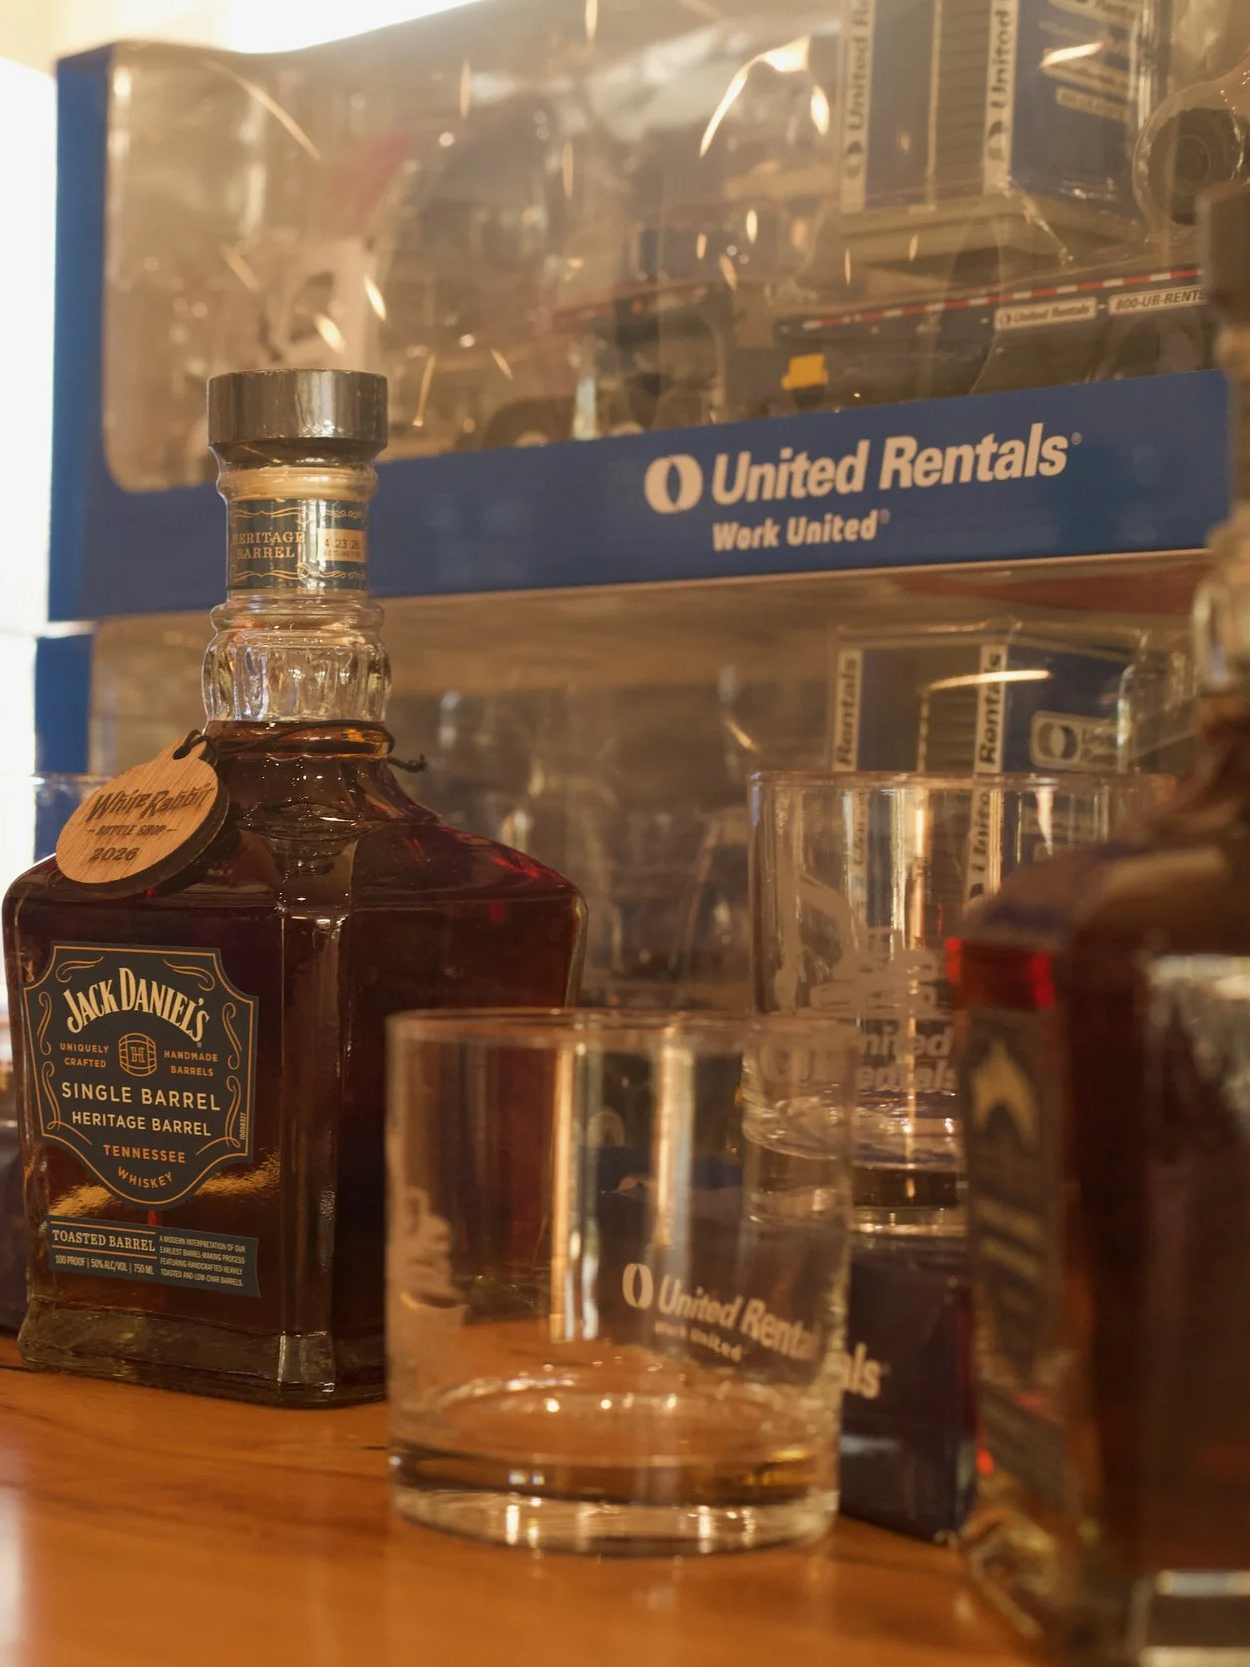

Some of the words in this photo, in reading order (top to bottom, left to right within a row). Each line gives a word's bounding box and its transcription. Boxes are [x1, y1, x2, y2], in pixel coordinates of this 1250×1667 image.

[711, 440, 871, 506] United
[879, 422, 1069, 490] Rentals
[712, 518, 779, 552] Work
[787, 509, 879, 546] United
[237, 546, 295, 559] BARREL
[85, 789, 151, 825] White
[137, 825, 167, 837] SHOP
[89, 847, 140, 862] 2026
[63, 979, 120, 1034] JACK
[118, 967, 210, 1042] DANIEL'S
[60, 1042, 109, 1054] UNIQUELY
[163, 1050, 219, 1063] HANDMADE
[64, 1057, 107, 1068] CRAFTED
[170, 1065, 214, 1077] BARRELS
[61, 1081, 132, 1103] SINGLE
[141, 1088, 221, 1111] BARREL
[72, 1111, 146, 1130] HERITAGE
[152, 1118, 212, 1137] BARREL
[103, 1144, 186, 1164] TENNESSEE
[117, 1166, 173, 1189] WHISKEY
[52, 1229, 106, 1246] TOASTED
[108, 1235, 156, 1252] BARREL
[658, 1274, 743, 1330] United
